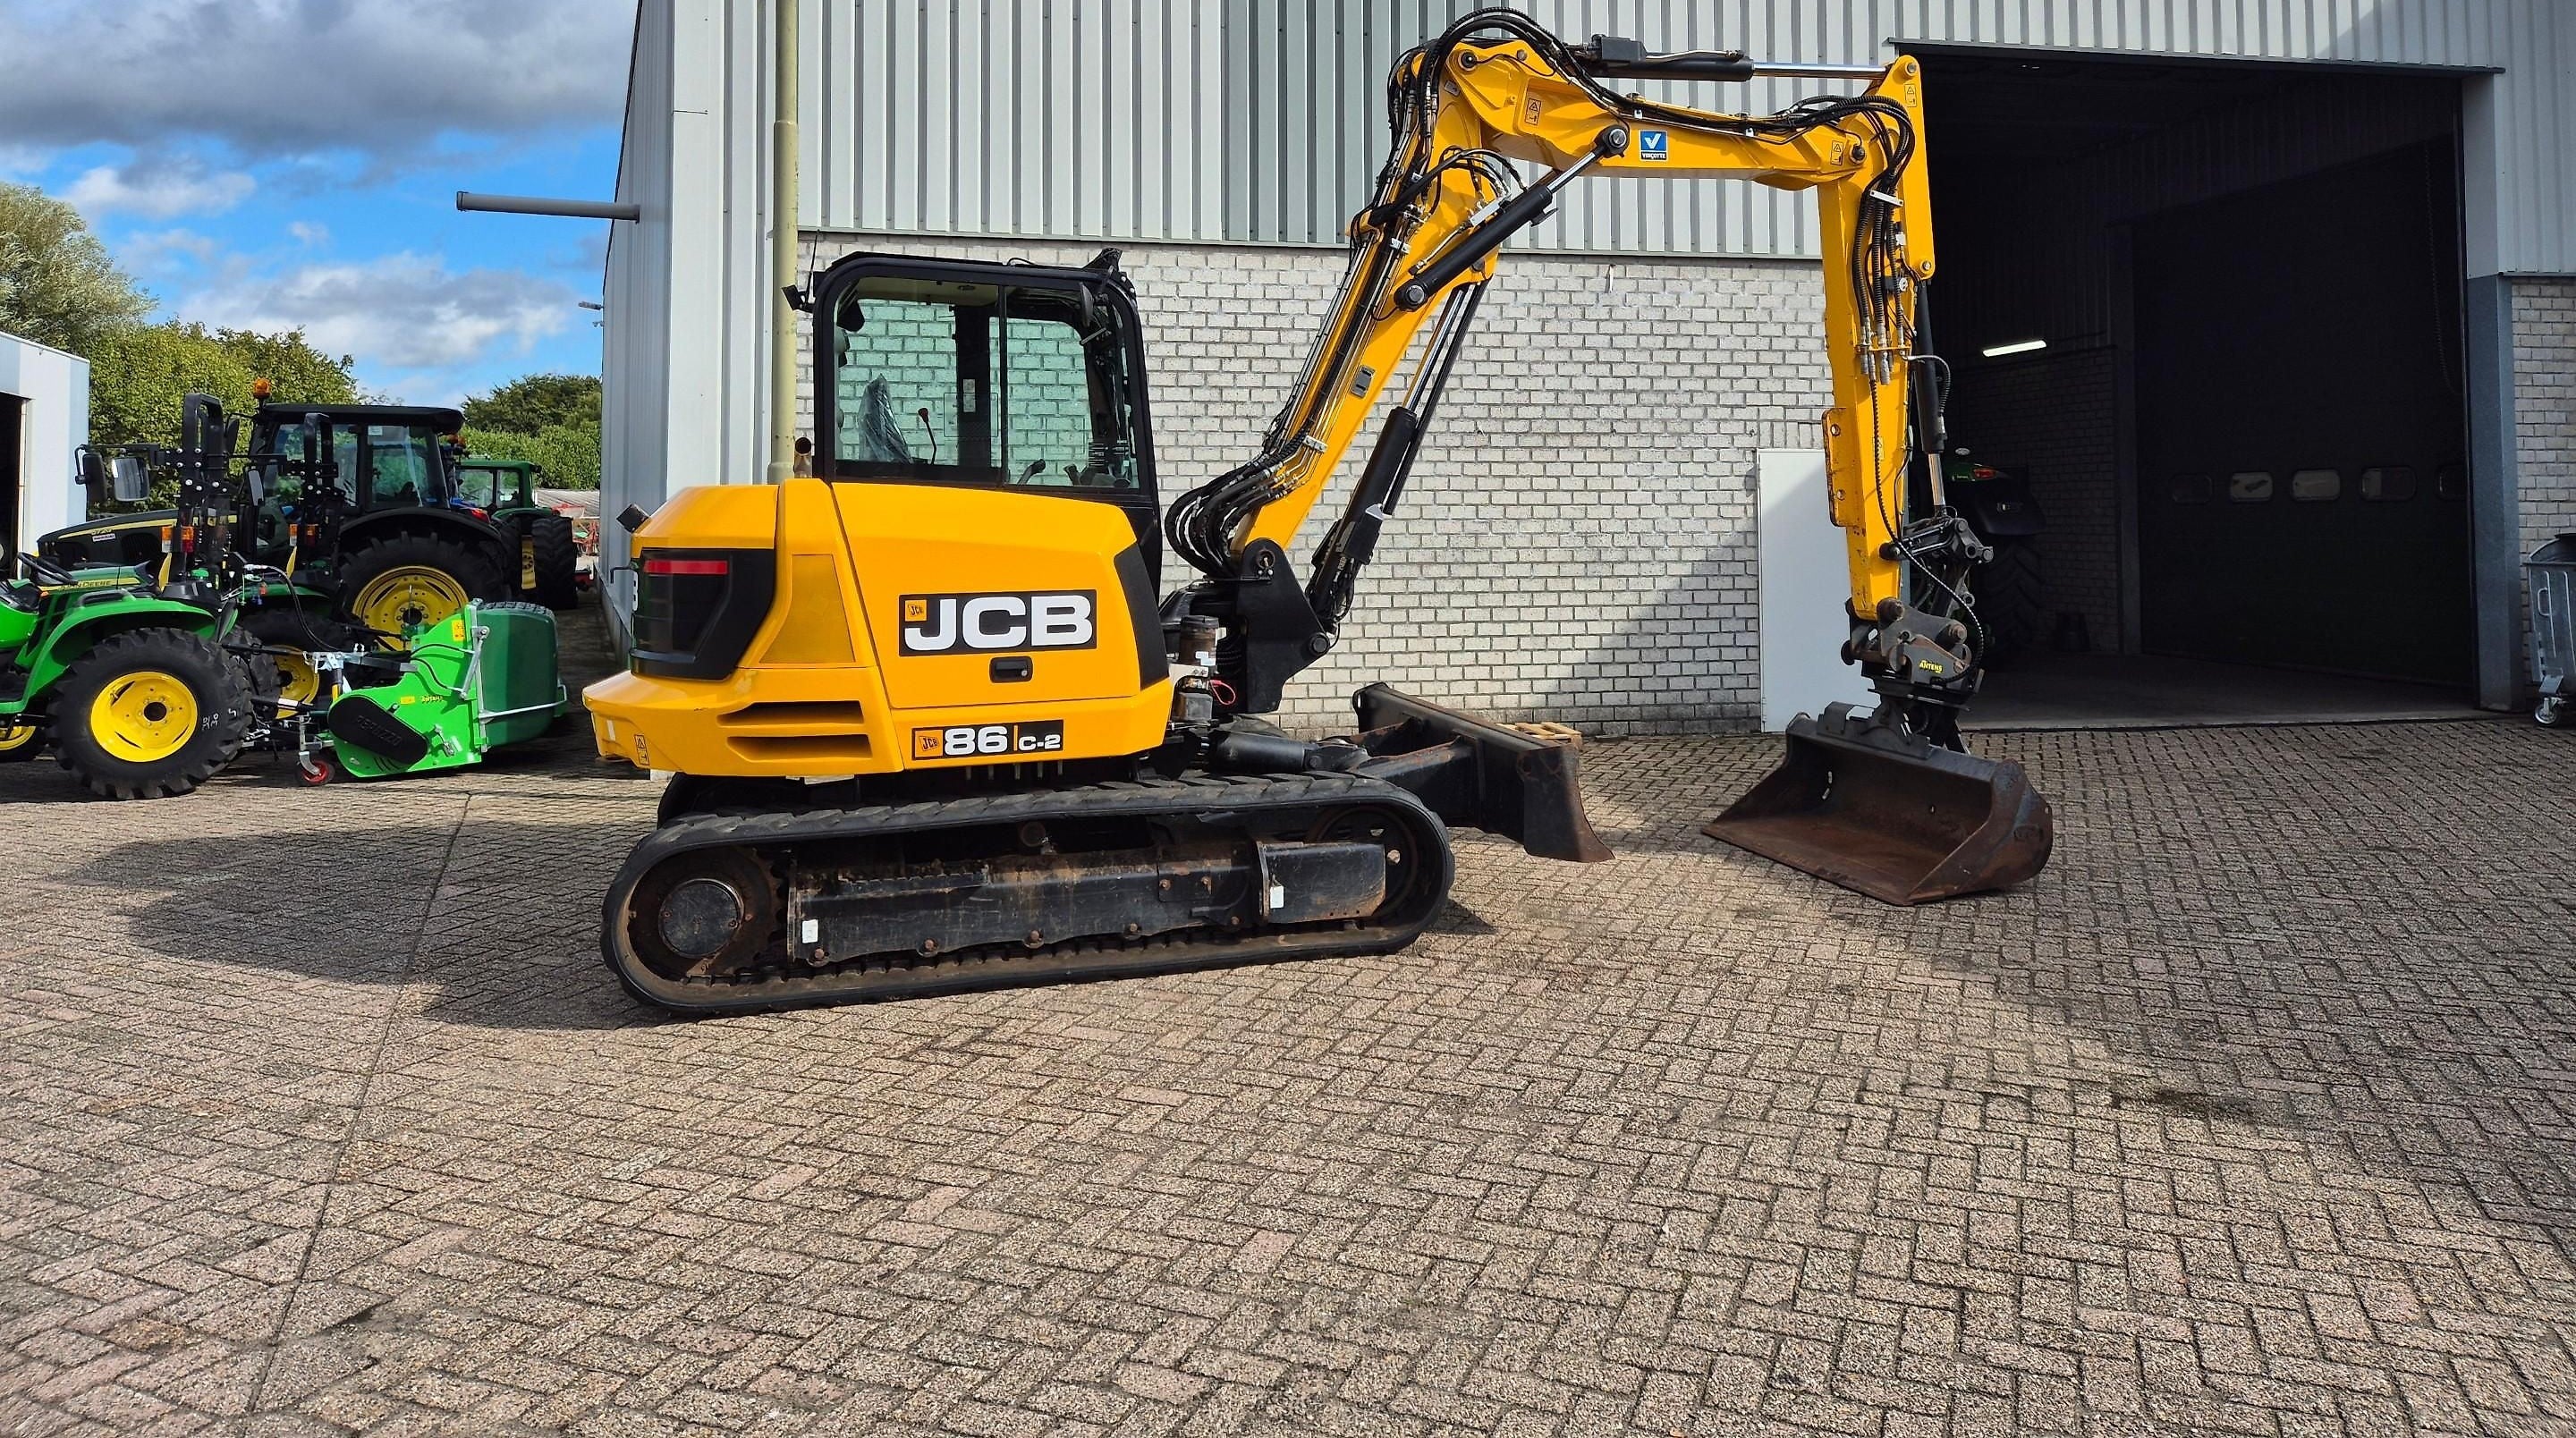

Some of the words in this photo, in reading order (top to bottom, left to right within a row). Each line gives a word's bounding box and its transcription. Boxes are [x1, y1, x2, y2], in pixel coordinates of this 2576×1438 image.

[904, 595, 1092, 651] JCB
[944, 725, 1008, 756] 86
[1019, 734, 1062, 750] C-2
